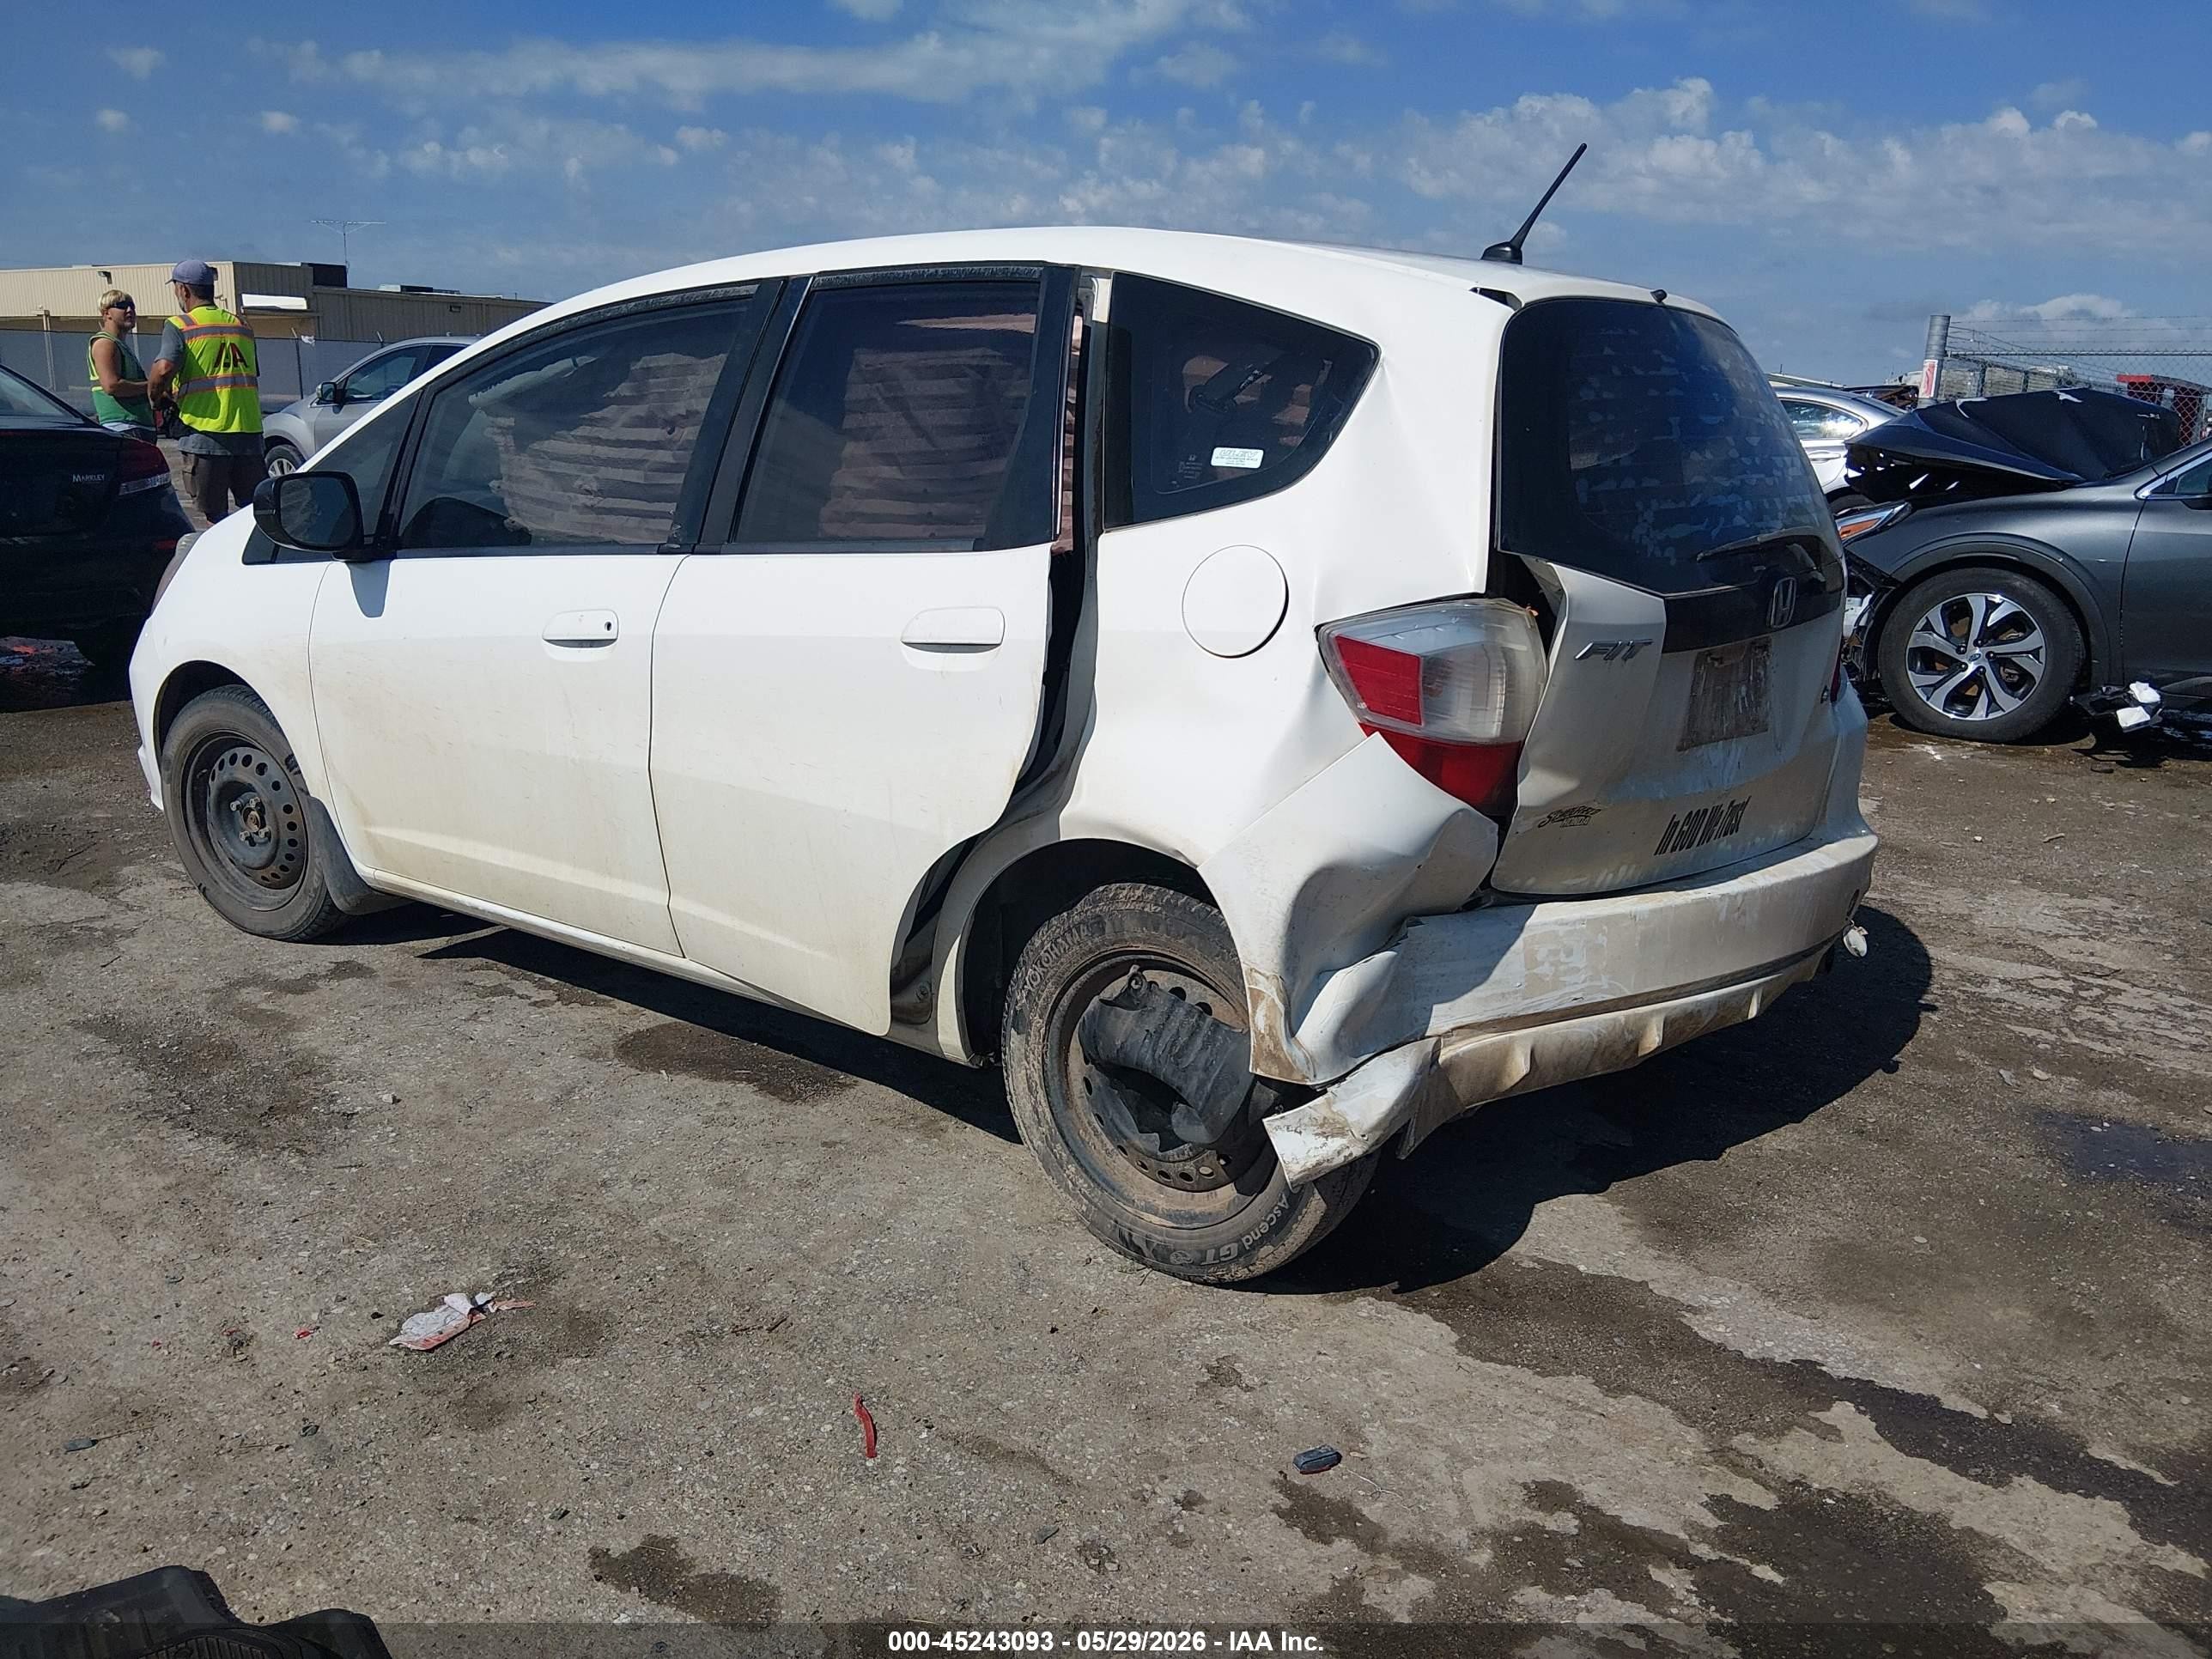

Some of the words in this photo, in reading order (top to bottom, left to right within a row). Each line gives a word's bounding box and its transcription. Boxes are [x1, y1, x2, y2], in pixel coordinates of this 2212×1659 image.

[1573, 639, 1654, 661] FIT
[1670, 807, 1709, 854] GOD
[1241, 1192, 1289, 1250] Ascend
[1200, 1243, 1239, 1266] GT
